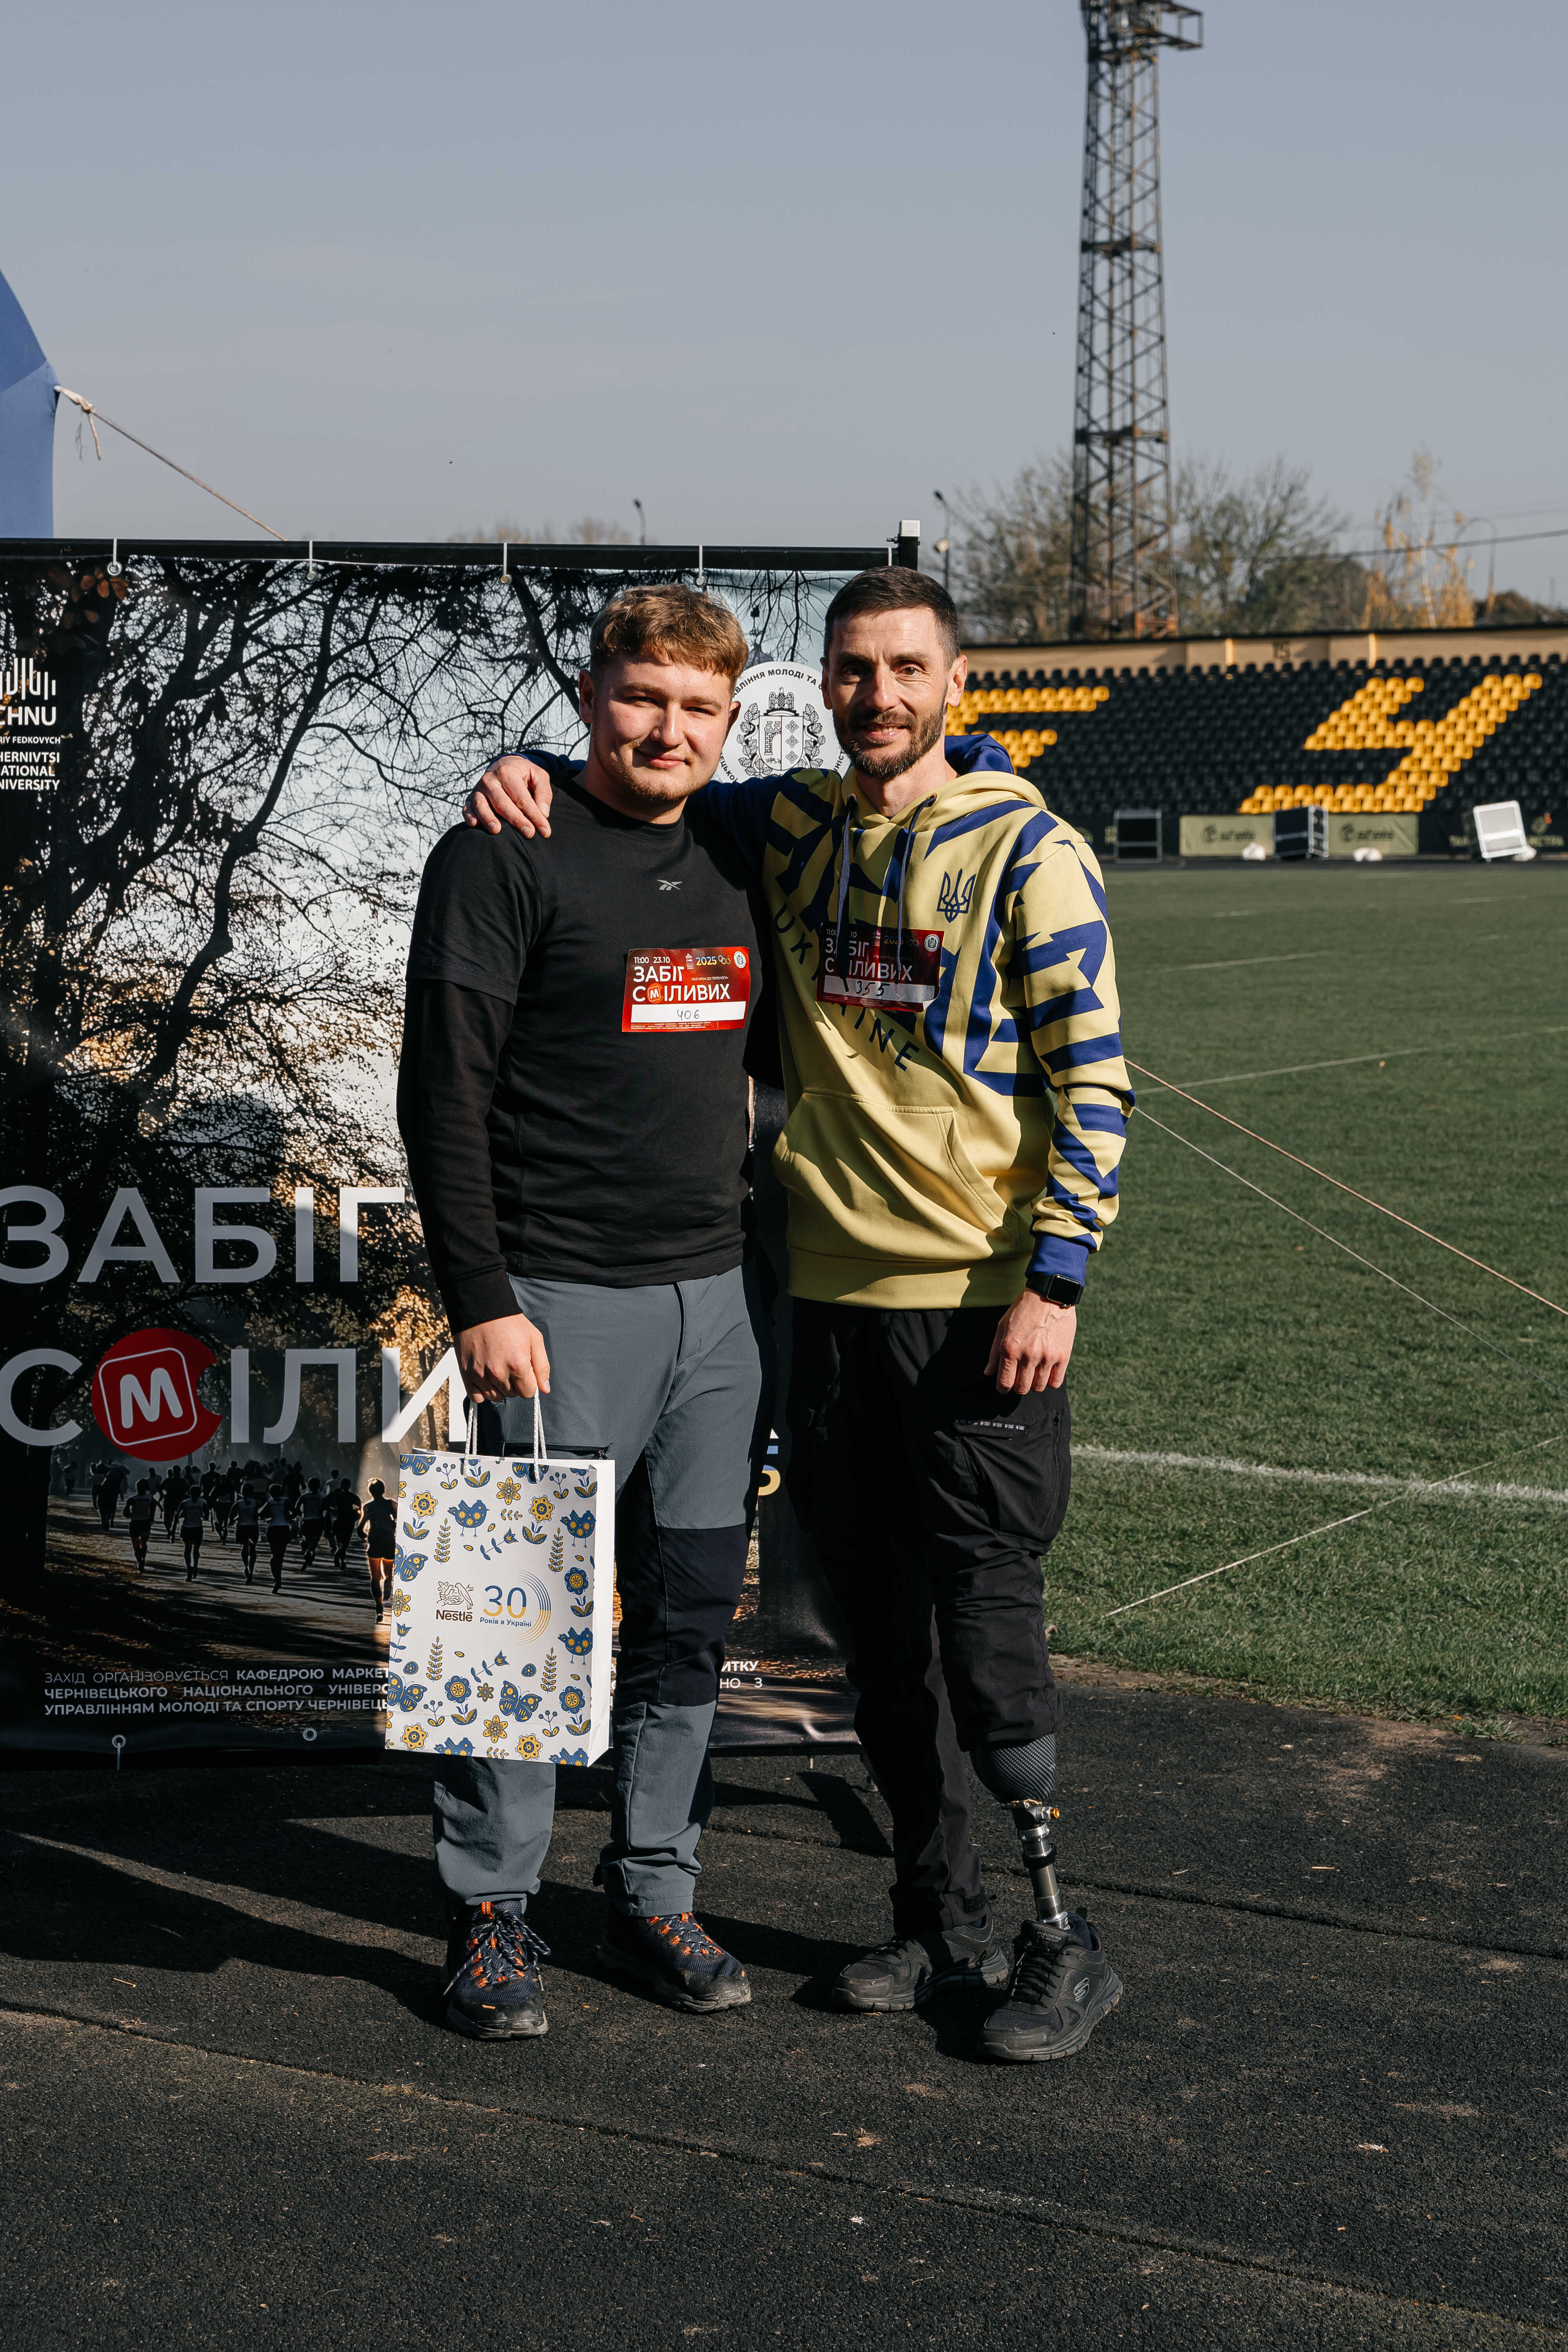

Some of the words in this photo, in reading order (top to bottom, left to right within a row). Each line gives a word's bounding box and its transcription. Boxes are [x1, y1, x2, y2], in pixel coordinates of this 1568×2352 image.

[768, 669, 804, 679] МОЛОДІ
[807, 675, 816, 685] ТА
[0, 751, 60, 763] HERNIVTSI
[833, 749, 845, 771] ІНІСТ
[1, 765, 55, 777] ATIONAL
[0, 779, 60, 790] NIVERSITY
[825, 938, 869, 957] ЗБІГ
[695, 956, 717, 966] 2025
[825, 957, 913, 981] СІЛИВИХ
[633, 966, 684, 982] ЗАБІГ
[774, 903, 920, 1072] UKINE
[855, 980, 890, 996] 355
[677, 1009, 699, 1020] 406
[0, 1185, 405, 1283] ЗАБІГ
[0, 1347, 467, 1446] СМІЛИ
[483, 1585, 526, 1619] 30
[507, 1619, 532, 1628] Україні
[45, 1673, 85, 1685] ЗАХІД
[93, 1670, 229, 1684] ОРГАНІЗОВУЄТЬСЯ
[236, 1668, 324, 1682] КАФЕДРОЮ
[332, 1668, 389, 1679] МАРКЕТ
[721, 1661, 759, 1672] ИТКУ
[45, 1687, 167, 1700] ЧЕРНІВЕЦЬКОГО
[183, 1684, 313, 1698] НАЦІОНАЛЬНОГО
[329, 1683, 388, 1694] УНІВЕРС
[45, 1703, 154, 1715] УПРАВЛІННЯМ
[159, 1702, 219, 1714] МОЛОДІ
[224, 1701, 241, 1711] ТА
[246, 1700, 304, 1711] СПОРТУ
[308, 1699, 387, 1711] ЧЕРНІВЕЦЬ
